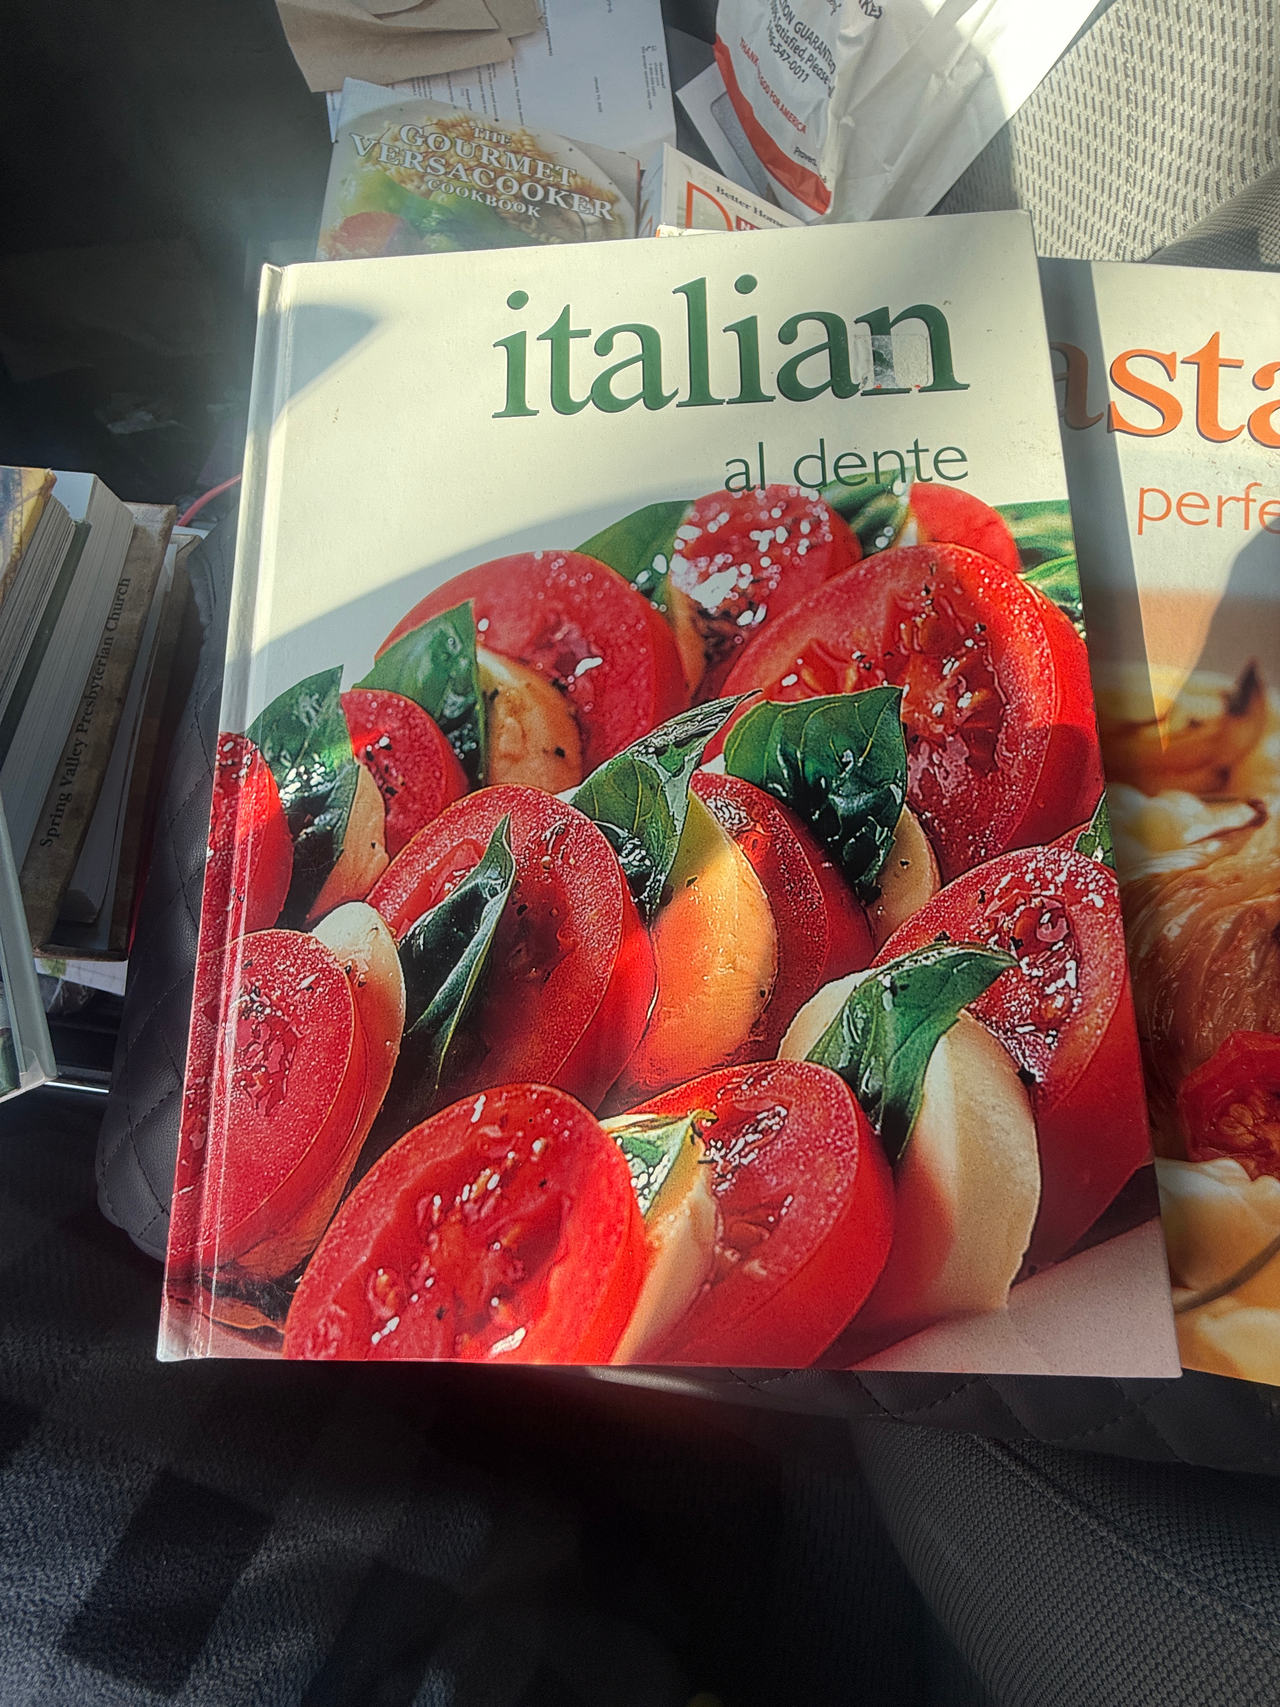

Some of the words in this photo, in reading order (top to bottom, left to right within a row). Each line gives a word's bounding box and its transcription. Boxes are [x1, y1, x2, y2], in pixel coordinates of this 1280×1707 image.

[472, 126, 512, 146] THE
[779, 104, 807, 134] AMERICA
[350, 133, 616, 221] VERSACOOKER
[400, 124, 577, 187] GOURMET
[427, 178, 543, 218] COOKBOOK
[716, 185, 751, 209] Better
[753, 206, 790, 228] Hom
[492, 274, 970, 418] italian
[724, 441, 765, 493] al
[793, 438, 969, 490] dente
[40, 792, 72, 848] Spring
[60, 738, 88, 788] Valley
[75, 636, 114, 733] Presbyterian
[105, 578, 131, 632] Church
